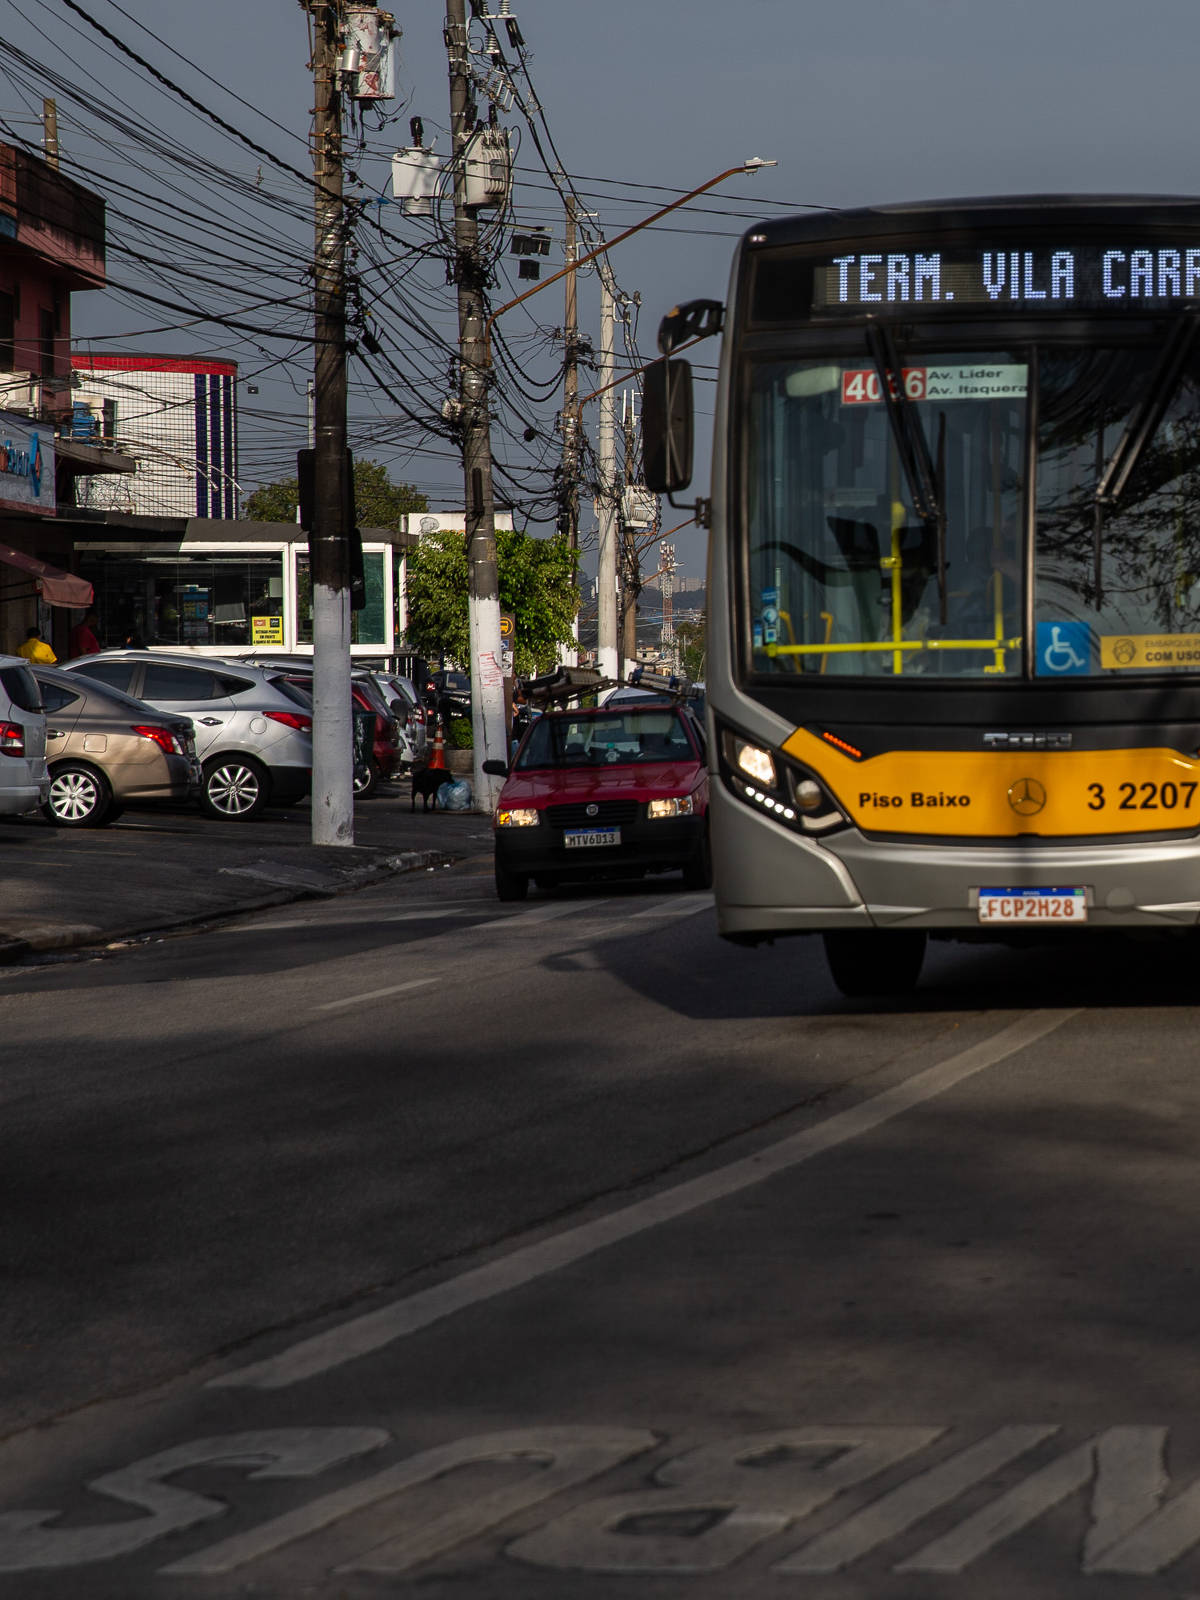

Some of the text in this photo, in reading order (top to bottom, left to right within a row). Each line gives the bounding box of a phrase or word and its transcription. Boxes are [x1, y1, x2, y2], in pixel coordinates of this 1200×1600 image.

[832, 253, 955, 302] TERM.
[983, 252, 1074, 299] VILA
[929, 371, 953, 380] Av.
[845, 371, 924, 400] 406
[928, 384, 1028, 396] Av. Itaquera
[1145, 651, 1173, 662] COM
[859, 791, 971, 807] Piso Baixo
[1088, 781, 1199, 810] 3 2207
[987, 898, 1075, 917] FCP2H28
